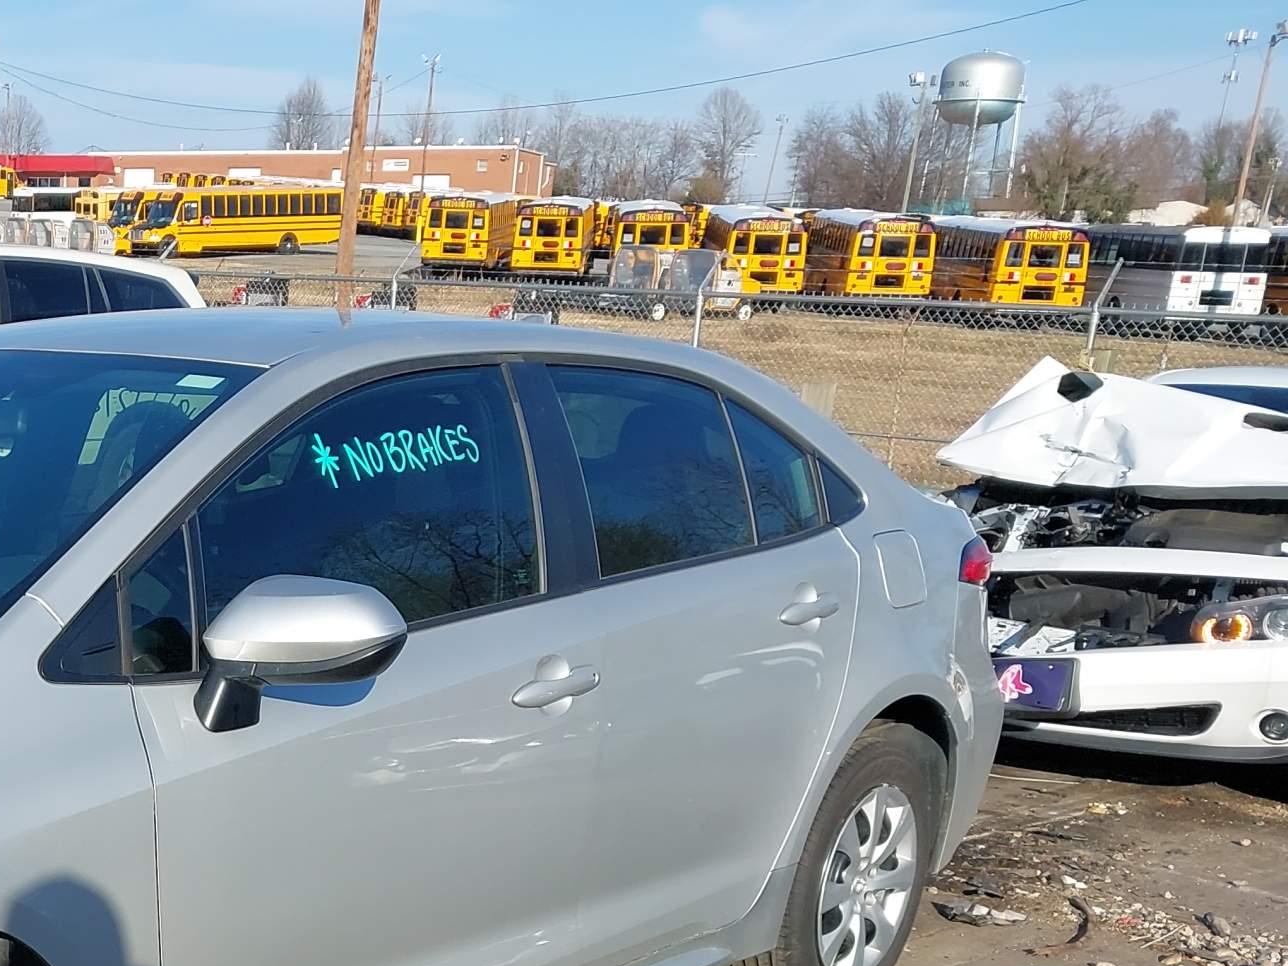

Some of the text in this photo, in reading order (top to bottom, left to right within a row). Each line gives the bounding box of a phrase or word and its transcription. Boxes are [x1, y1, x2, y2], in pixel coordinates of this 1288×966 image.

[877, 223, 919, 233] SCHOOL BUS
[1027, 230, 1071, 240] SCHOOL BUS
[342, 424, 480, 483] NO BRAKES
